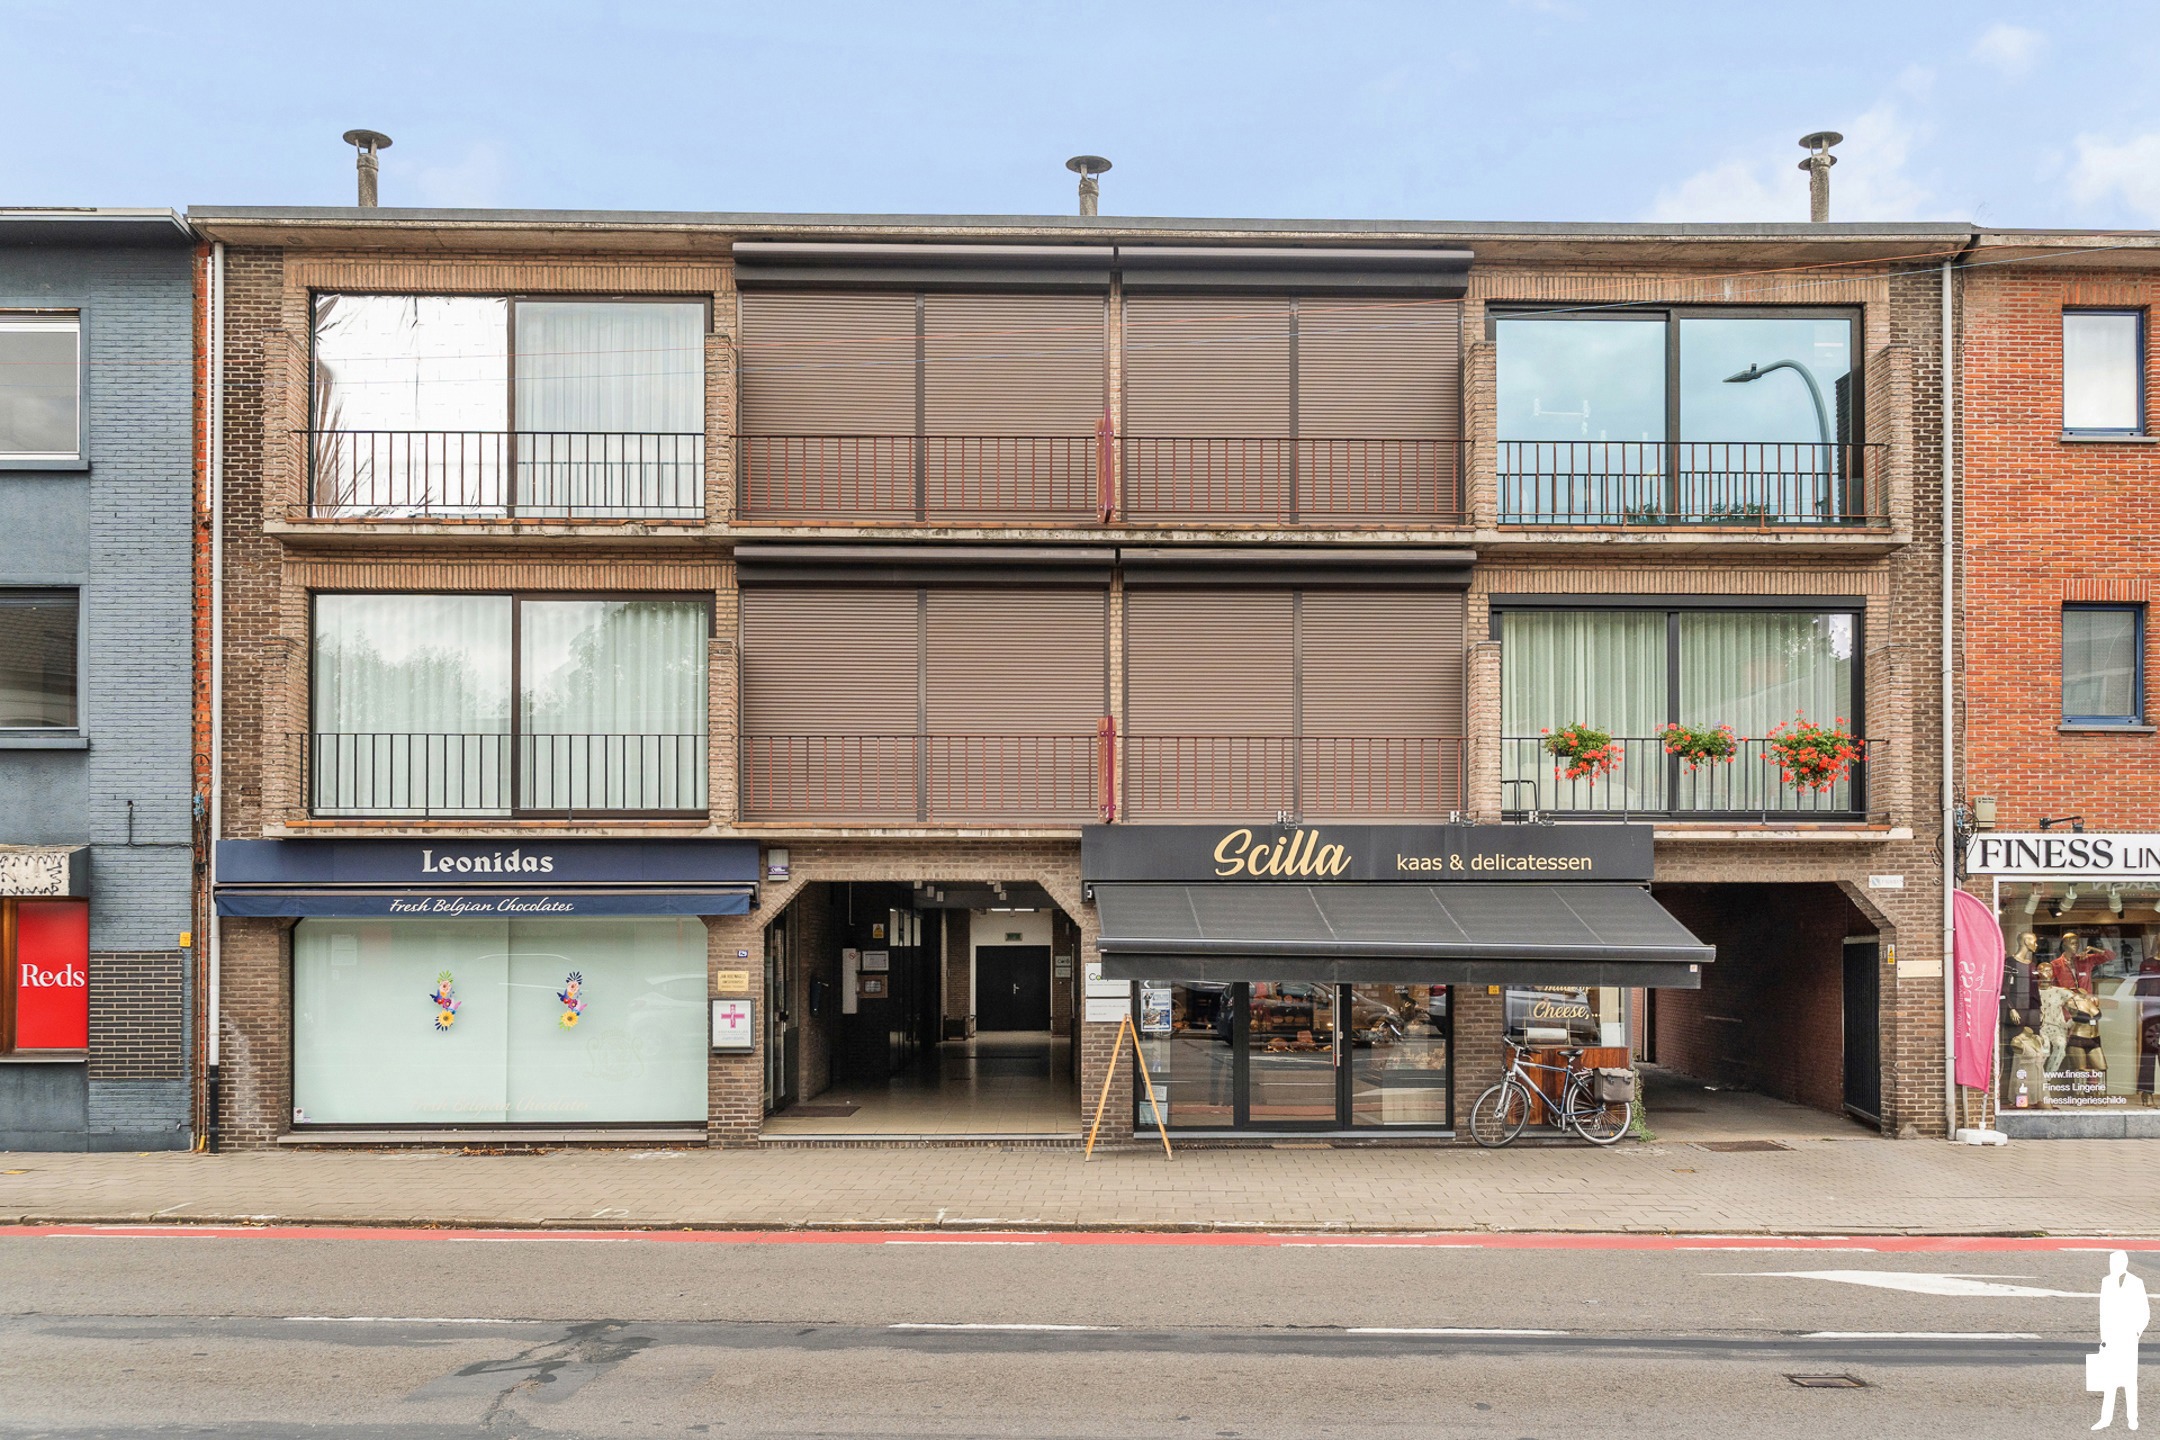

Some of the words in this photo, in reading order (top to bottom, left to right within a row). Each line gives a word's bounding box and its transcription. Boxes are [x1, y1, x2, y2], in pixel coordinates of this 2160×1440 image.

[422, 848, 554, 873] Leonidas
[1214, 828, 1352, 876] Scilla
[1396, 853, 1443, 871] kaas
[1449, 853, 1465, 871] &
[1470, 853, 1592, 871] delicatessen
[1979, 838, 2114, 868] FINESS
[2124, 847, 2160, 868] LIN
[389, 897, 432, 912] Fresh
[432, 897, 495, 916] Belgian
[496, 896, 575, 912] Chocolates
[20, 963, 86, 988] Reds
[2042, 1069, 2103, 1079] www.finess.be
[2042, 1083, 2071, 1092] Finess
[2072, 1082, 2107, 1093] Lingerie
